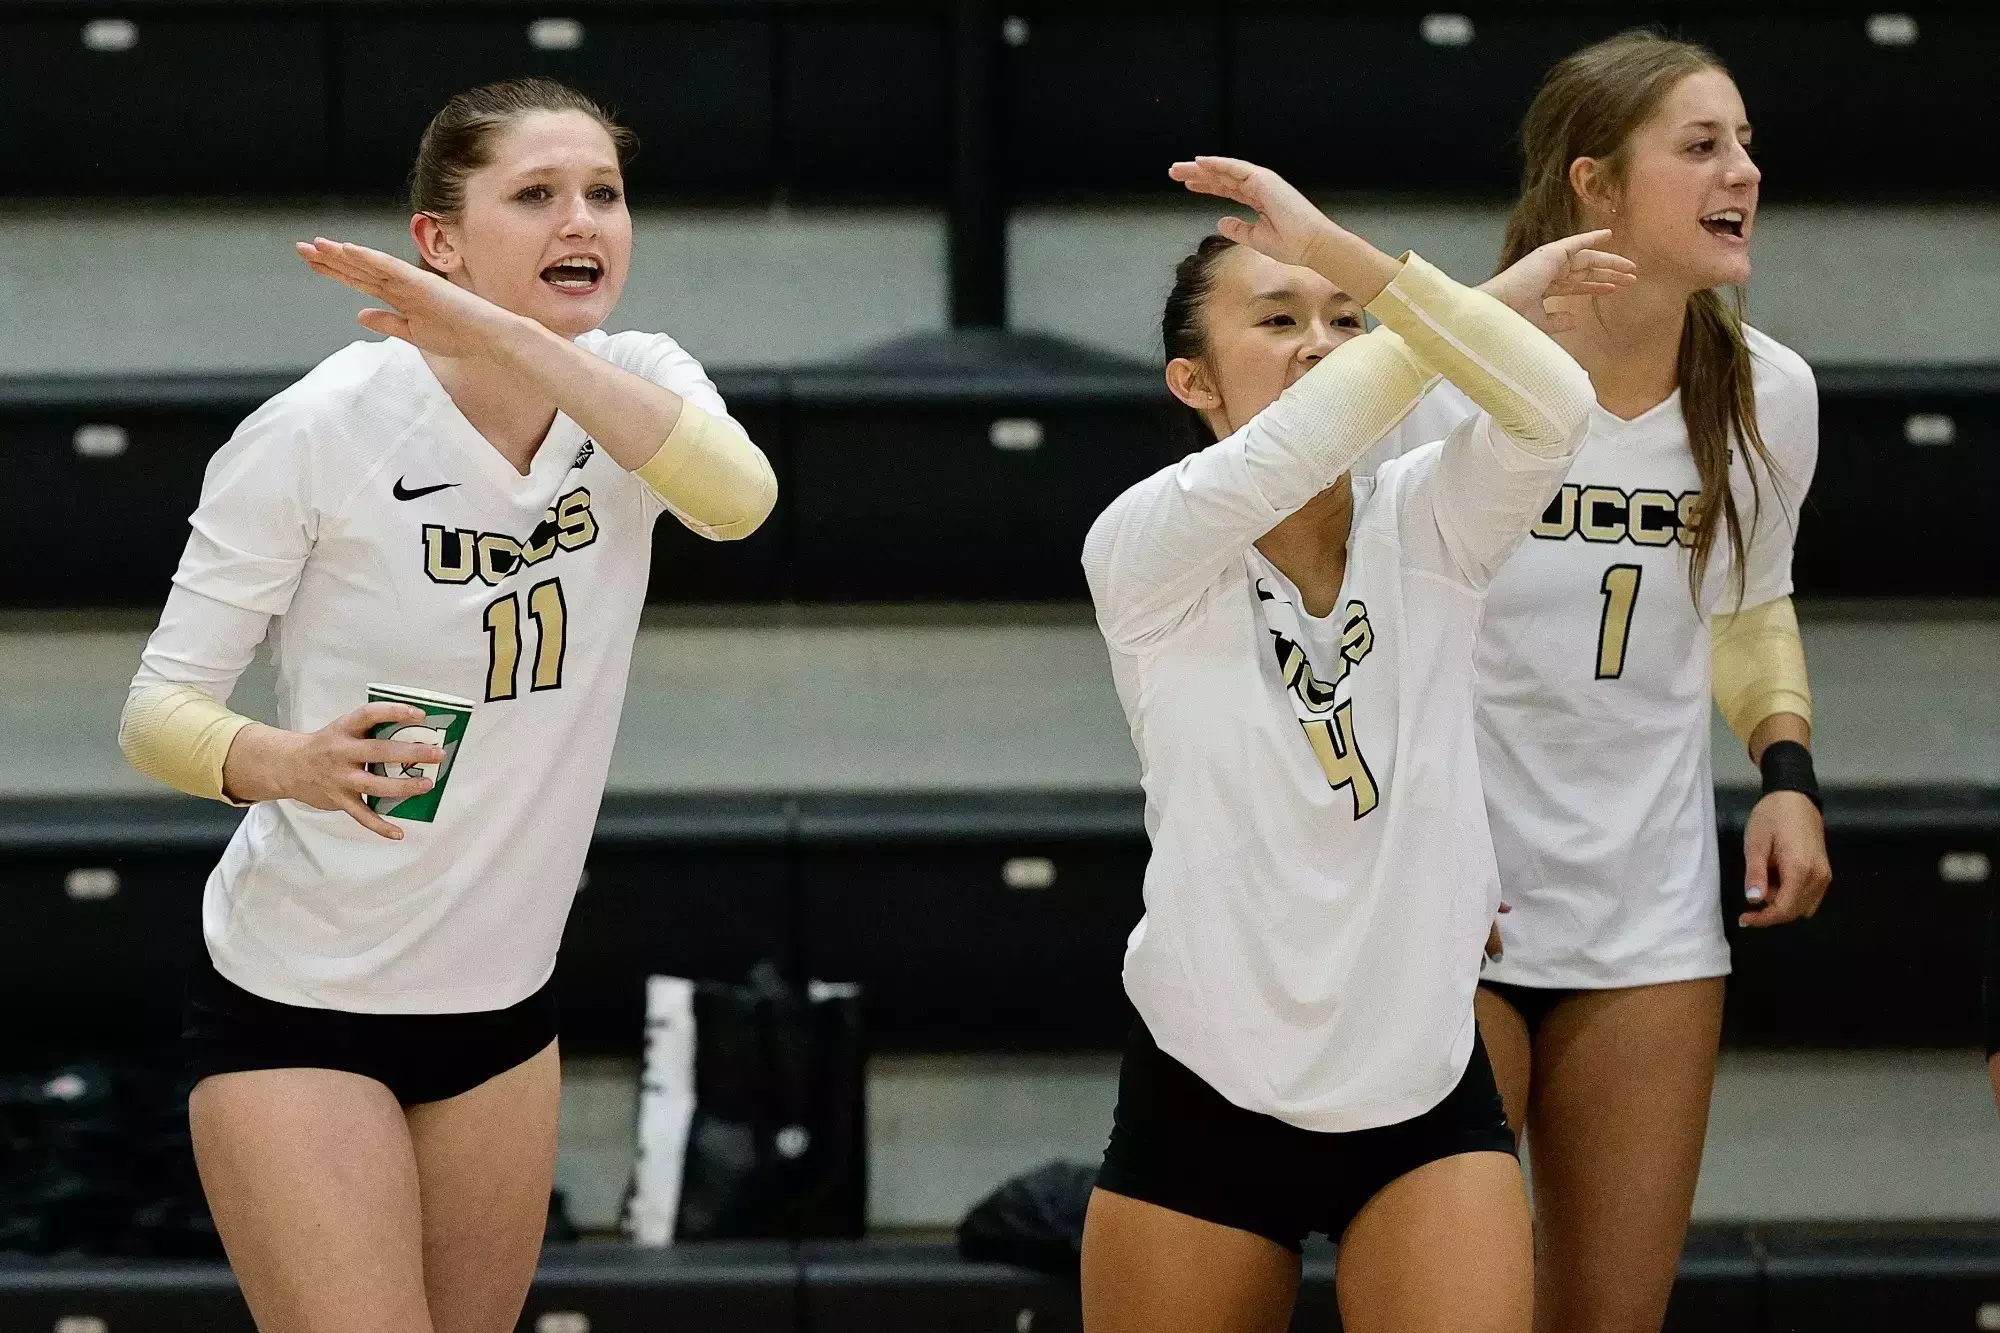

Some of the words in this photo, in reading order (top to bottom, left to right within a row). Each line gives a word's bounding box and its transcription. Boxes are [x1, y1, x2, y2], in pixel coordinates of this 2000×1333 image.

[422, 487, 599, 586] UCCS
[482, 577, 568, 703] 11
[1595, 564, 1643, 680] 1
[1299, 697, 1380, 821] 4
